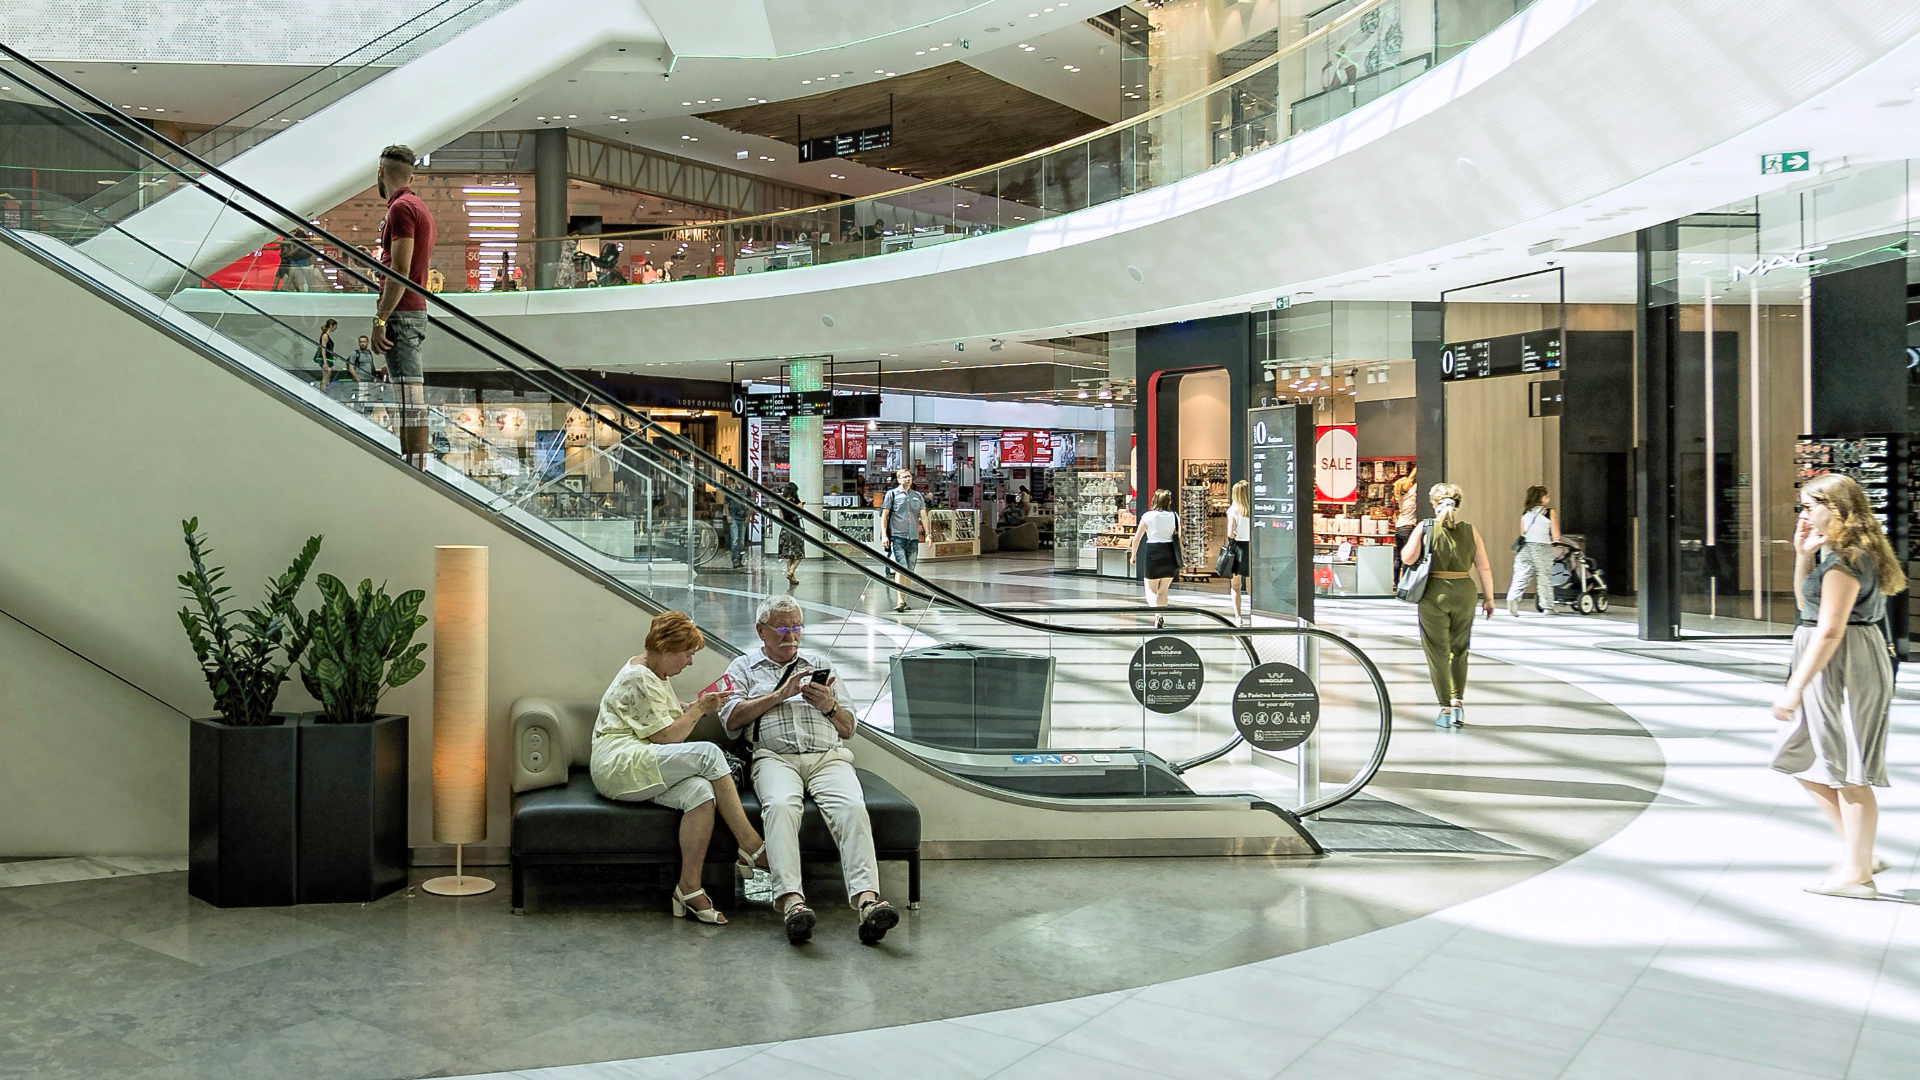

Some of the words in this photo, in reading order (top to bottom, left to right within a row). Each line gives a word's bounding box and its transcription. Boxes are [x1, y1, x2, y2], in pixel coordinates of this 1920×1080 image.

[801, 144, 808, 159] 1
[1442, 350, 1454, 374] 0
[734, 398, 744, 414] 0
[1256, 421, 1267, 445] 0
[749, 423, 760, 469] Markt
[1321, 457, 1353, 471] SALE
[1169, 669, 1183, 677] safety
[1278, 700, 1296, 708] safety
